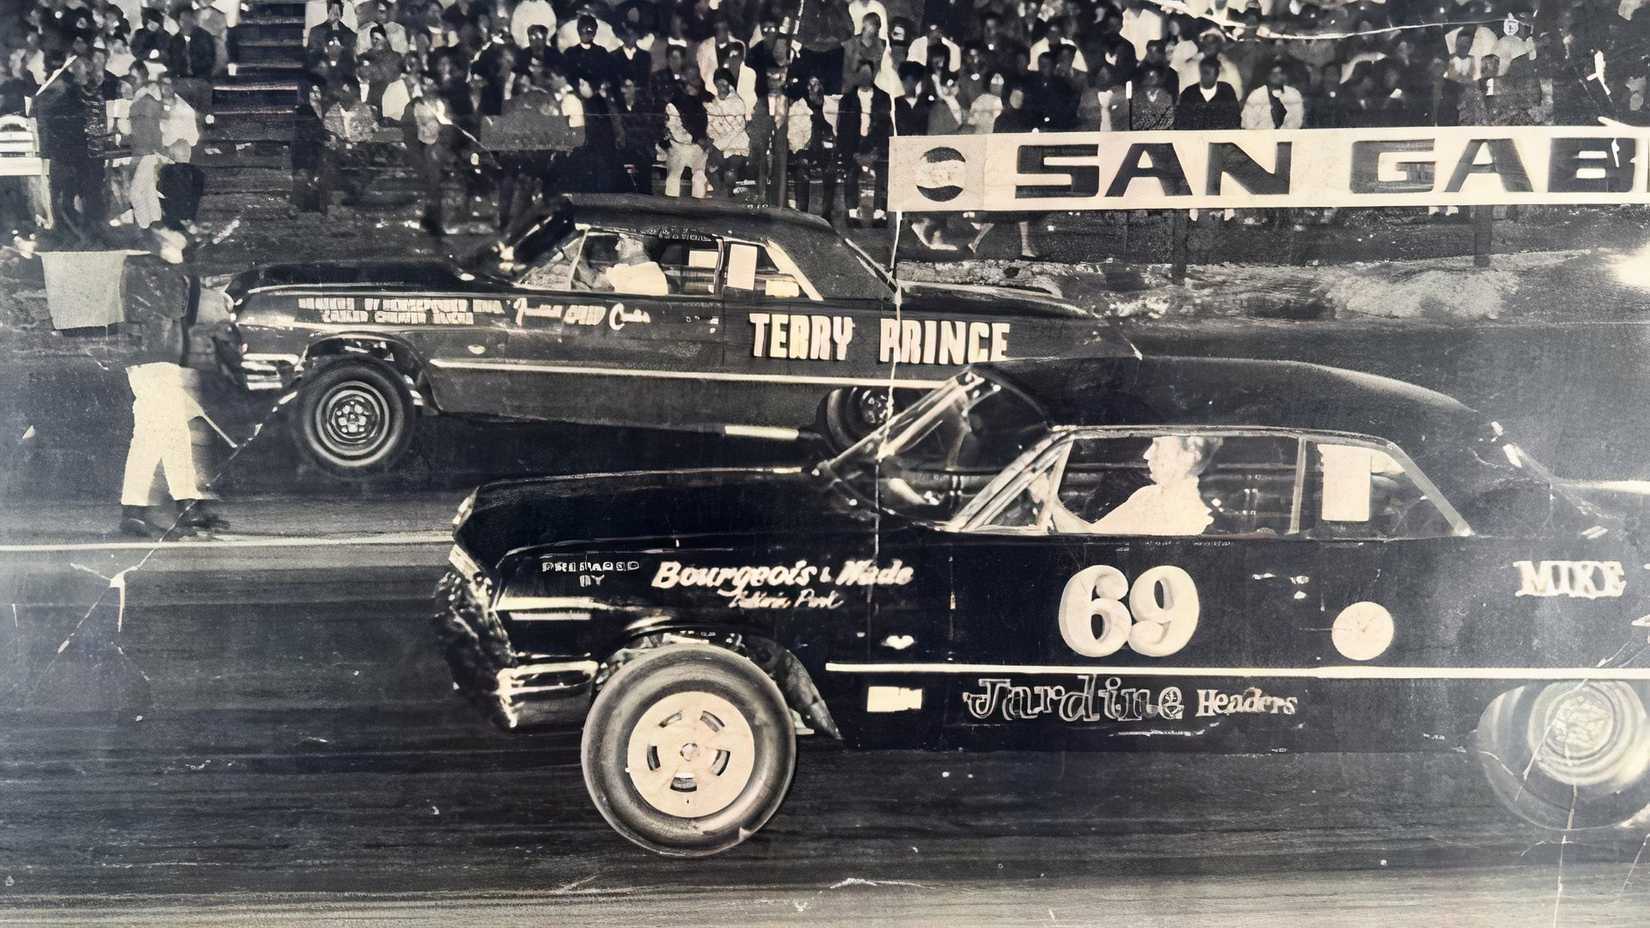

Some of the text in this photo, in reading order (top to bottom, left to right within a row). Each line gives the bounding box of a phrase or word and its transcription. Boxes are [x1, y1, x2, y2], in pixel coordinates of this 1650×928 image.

[1015, 137, 1650, 199] SAN GAB
[749, 313, 1010, 365] TERRY PRINCE
[651, 560, 817, 596] Bourgeois
[1512, 560, 1627, 600] MIKE
[1058, 564, 1200, 658] 69
[963, 674, 1298, 722] Jardine Headers
